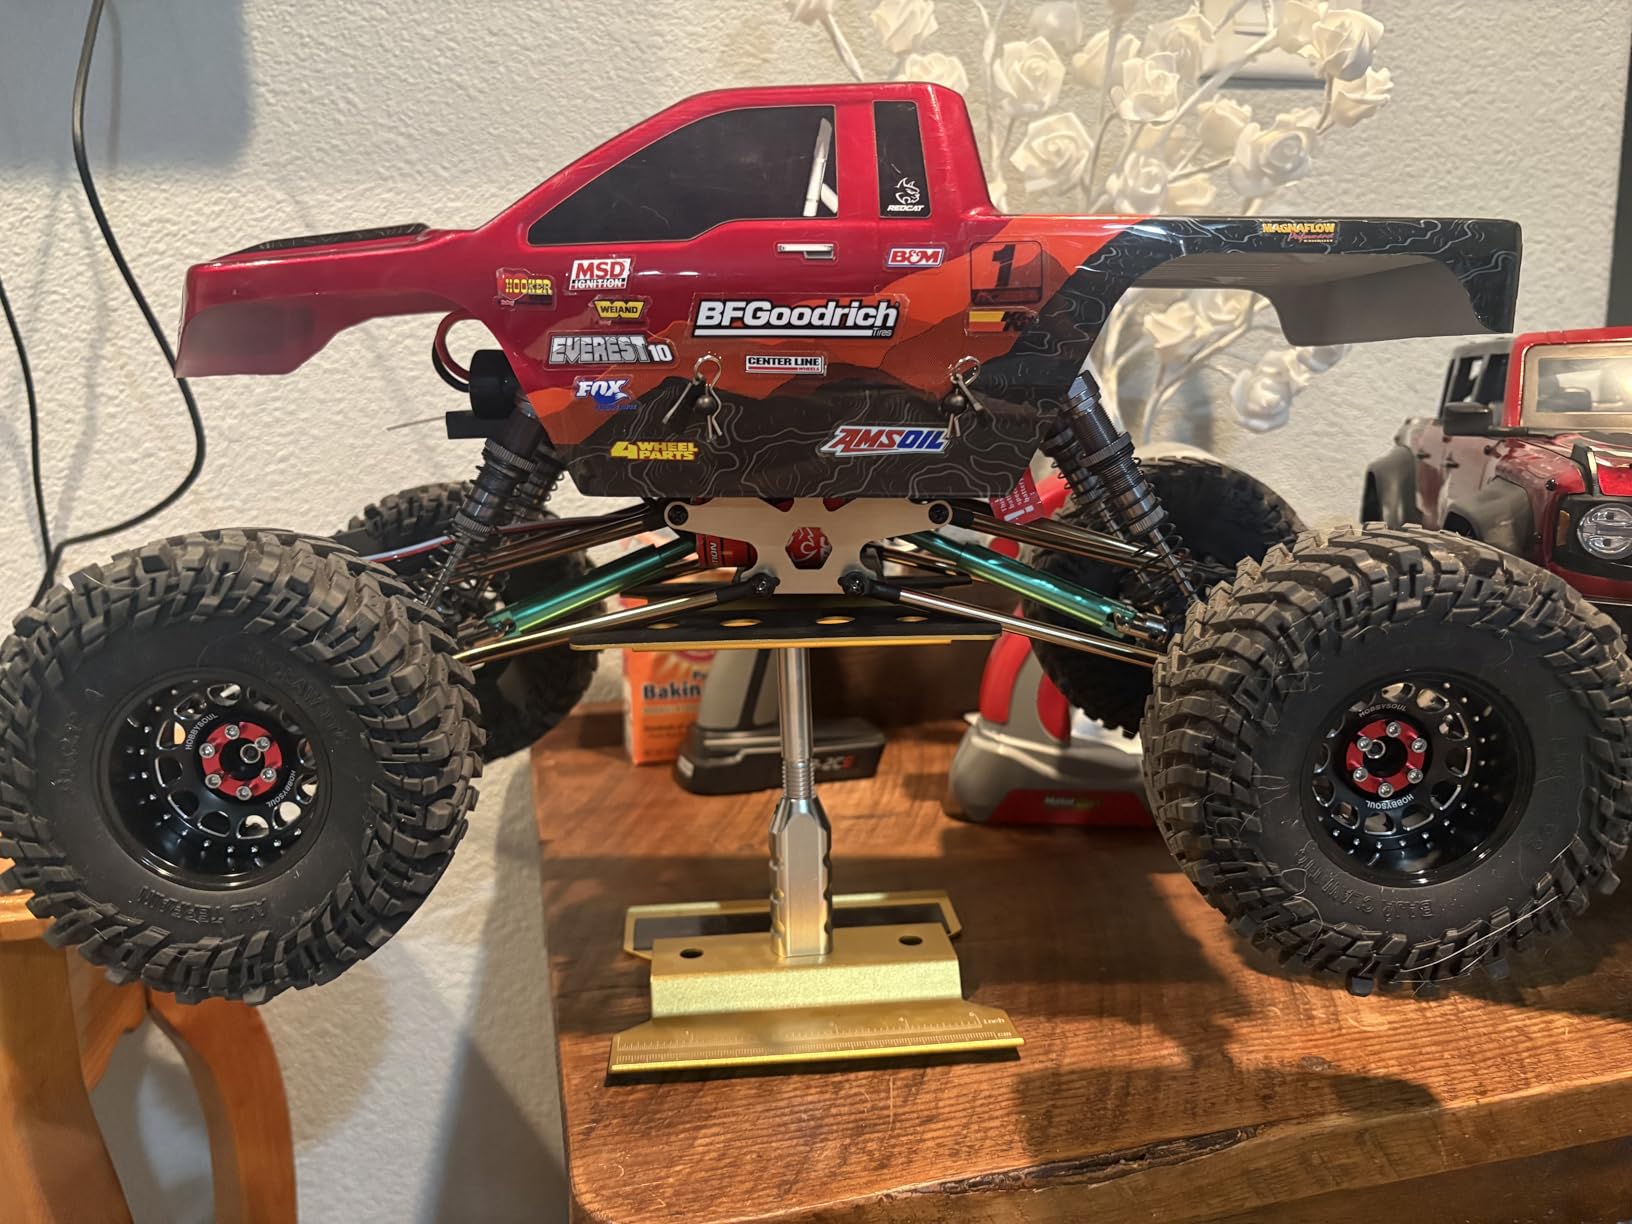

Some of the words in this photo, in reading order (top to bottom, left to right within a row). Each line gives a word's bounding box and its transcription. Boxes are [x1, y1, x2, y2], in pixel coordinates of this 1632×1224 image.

[887, 204, 924, 212] REDCAT
[1262, 223, 1336, 233] MAGNAFLOW
[891, 250, 941, 265] B&M
[991, 244, 1016, 288] 1
[575, 261, 626, 279] MSD
[505, 279, 552, 295] HOOKER
[574, 279, 622, 289] IGNITION
[600, 305, 638, 314] WEIAND
[696, 301, 898, 327] BFGoodrich
[550, 335, 650, 364] EVEREST
[648, 344, 673, 362] 10
[748, 357, 792, 366] CENTER
[794, 358, 820, 367] LINE
[576, 380, 627, 397] FOX
[828, 428, 945, 453] AMSOIL
[610, 441, 637, 460] 4
[639, 441, 698, 451] WHEEL
[639, 451, 695, 460] PARTS
[1358, 703, 1408, 718] HOBBYSOUL
[185, 713, 218, 750] HOBBYSOUL
[266, 770, 296, 808] HOBBYSOUL
[1365, 793, 1415, 810] HOBBYSOUL
